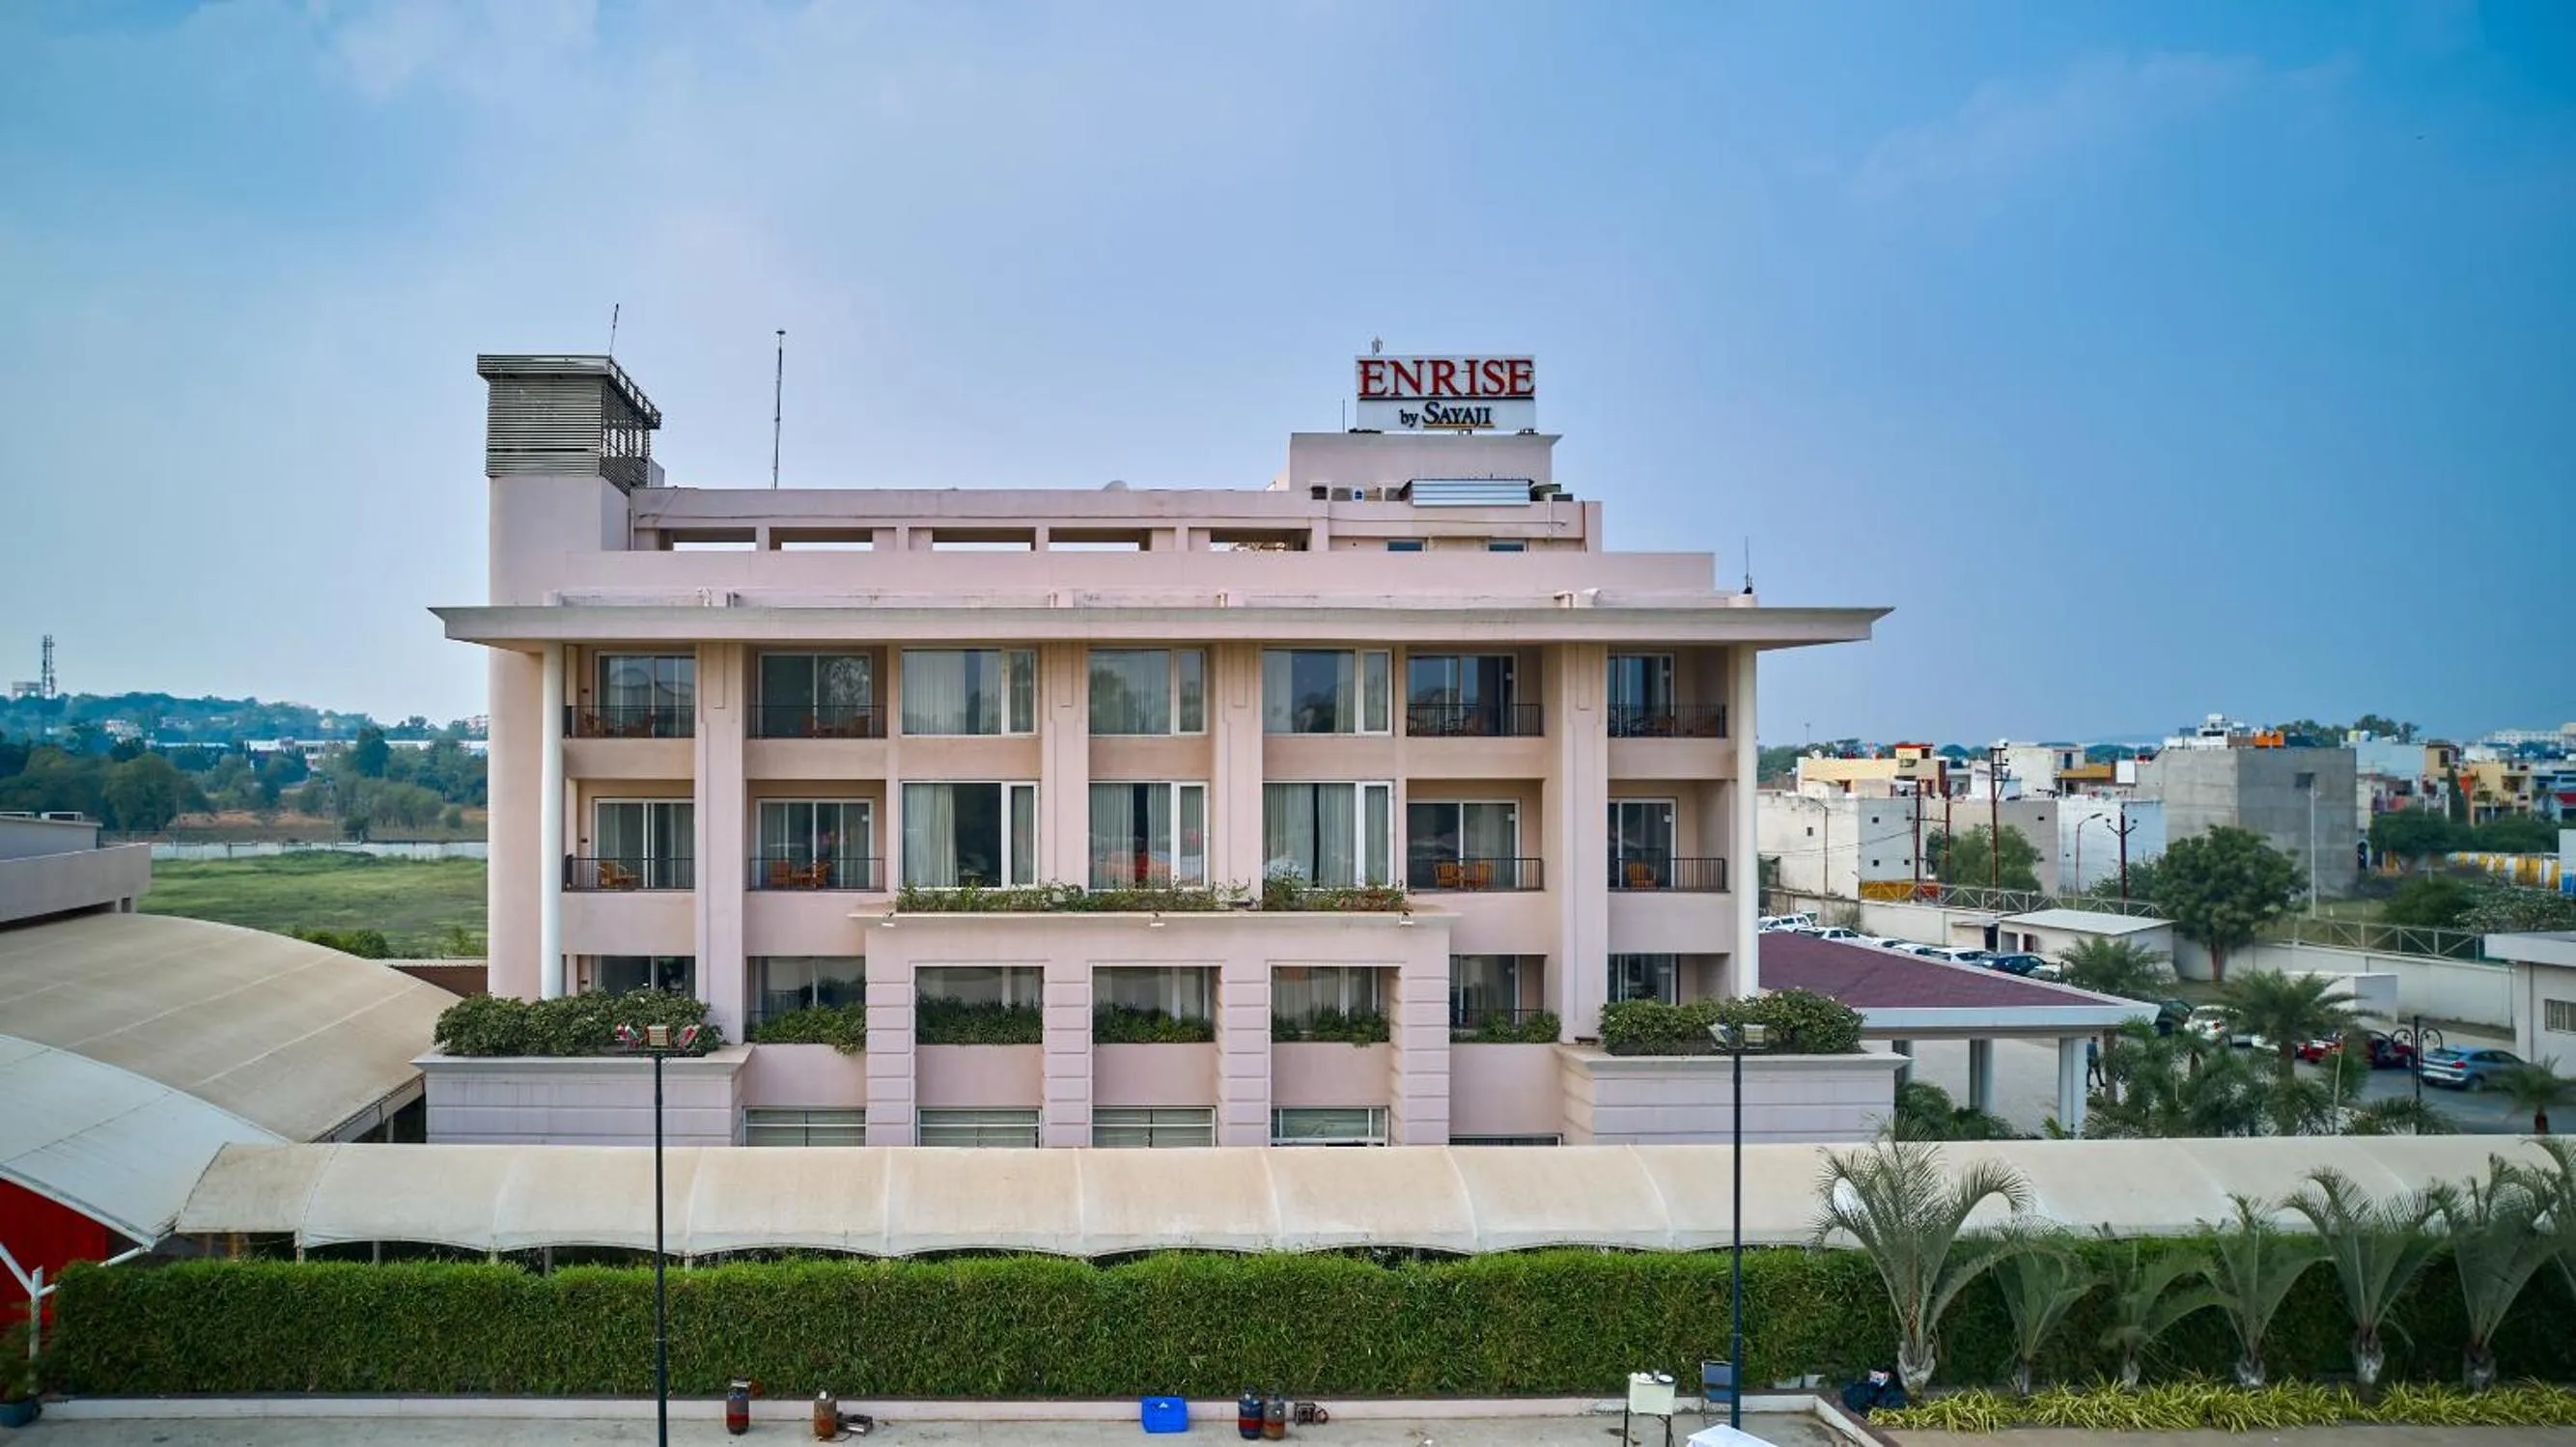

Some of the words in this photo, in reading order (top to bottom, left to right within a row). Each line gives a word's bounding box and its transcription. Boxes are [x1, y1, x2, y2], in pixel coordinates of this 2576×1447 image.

[1358, 359, 1534, 396] ENRISE
[1399, 409, 1418, 428] by
[1422, 401, 1491, 425] SAYAJI
